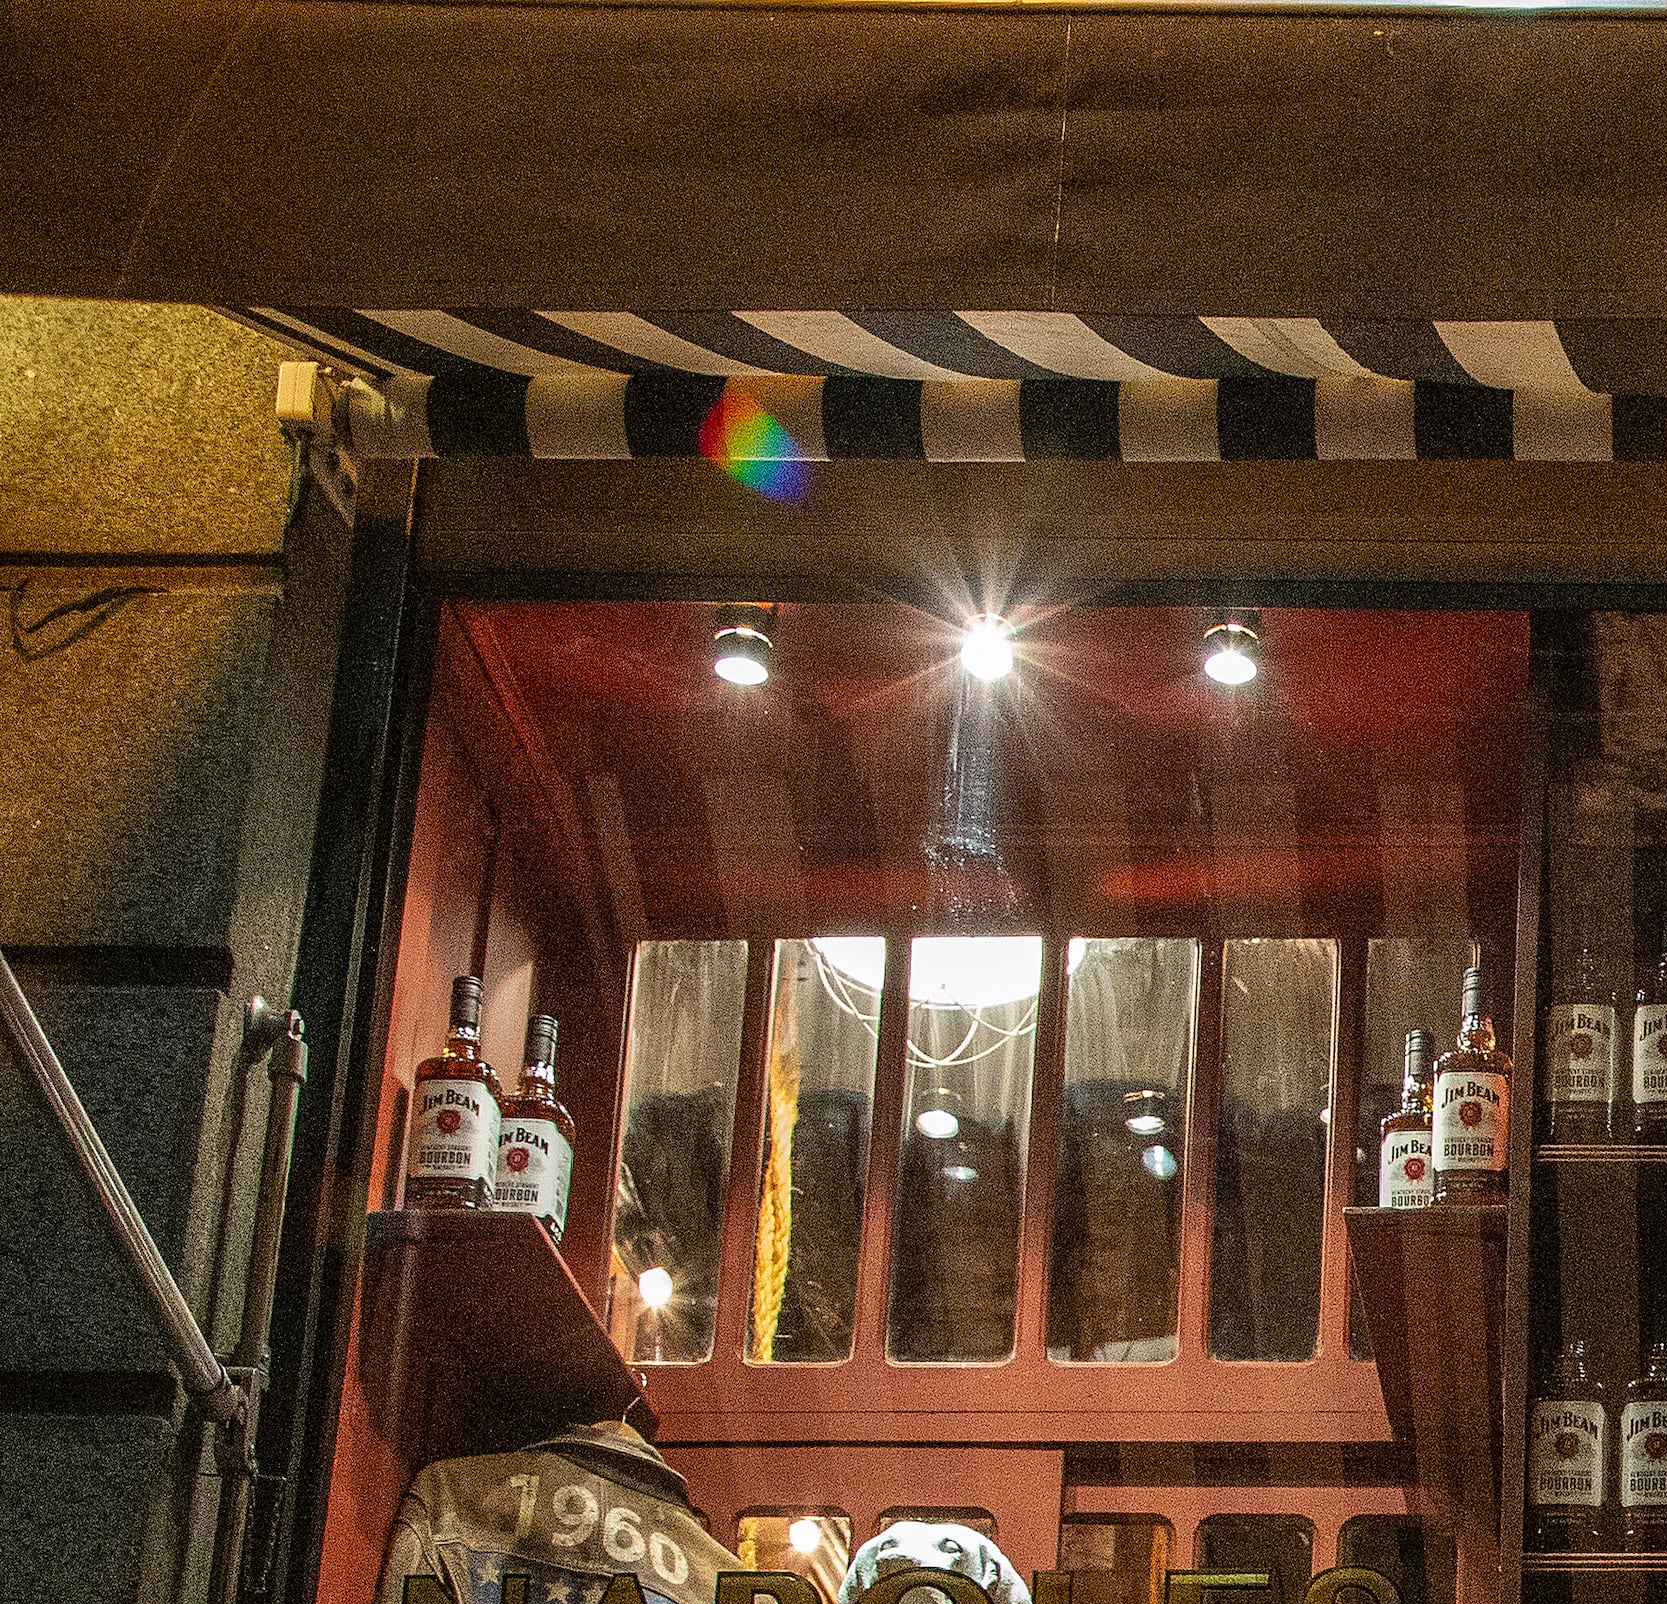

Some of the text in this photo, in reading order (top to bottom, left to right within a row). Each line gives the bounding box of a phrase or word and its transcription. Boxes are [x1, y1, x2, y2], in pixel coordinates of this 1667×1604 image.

[1639, 1019, 1662, 1042] JIM
[423, 1089, 480, 1116] JIM BEAM
[1441, 1081, 1500, 1108] JIM BEAM
[515, 1127, 550, 1155] BEAM
[1388, 1139, 1432, 1165] JIM BEA
[1444, 1145, 1494, 1157] BOURBON
[494, 1188, 539, 1202] OURBON
[1391, 1195, 1430, 1207] BOURBO
[1562, 1411, 1598, 1439] BEAM
[1626, 1418, 1649, 1442] JIM
[508, 1474, 690, 1585] 1960
